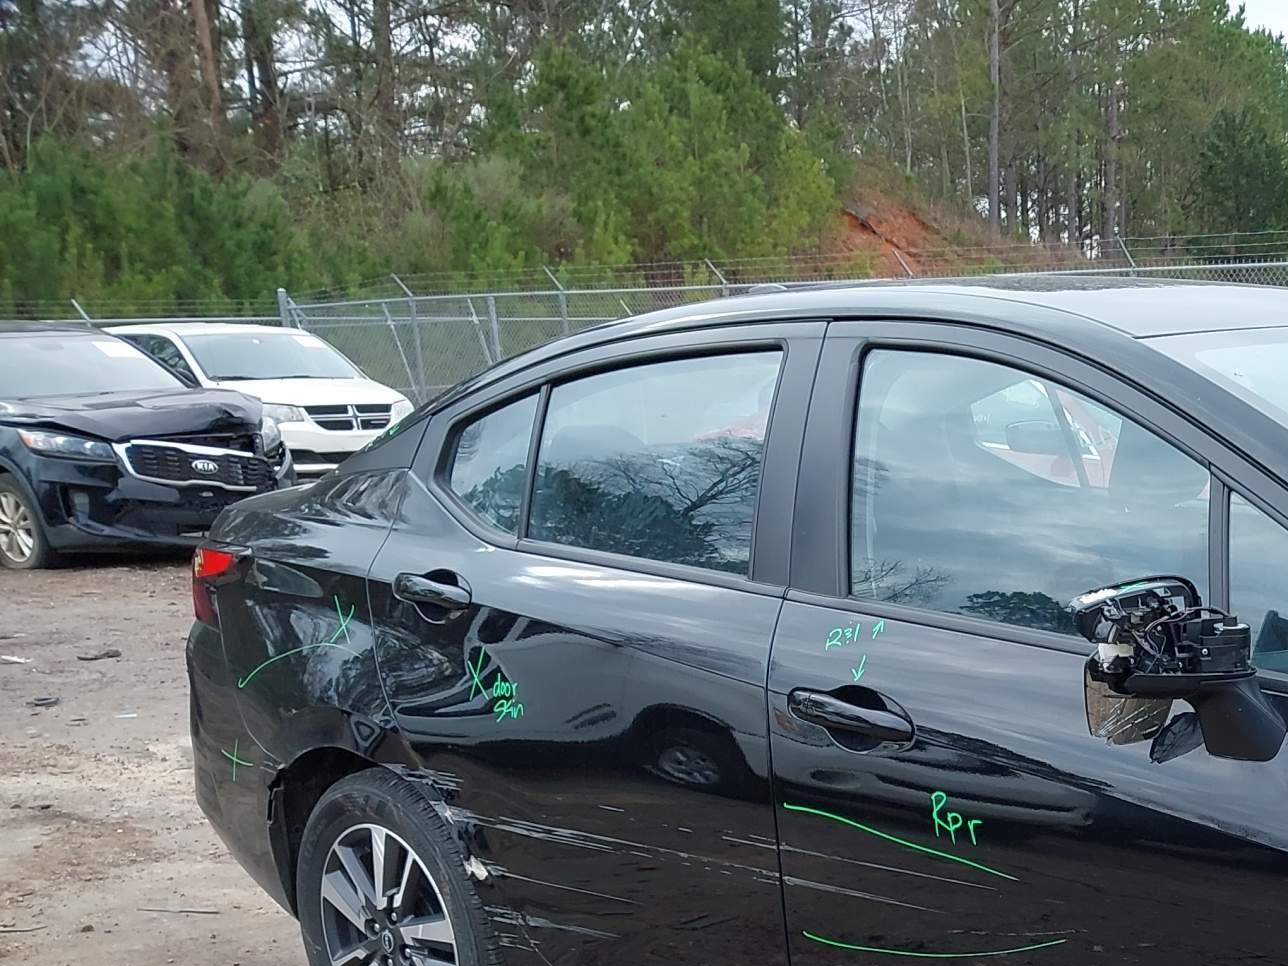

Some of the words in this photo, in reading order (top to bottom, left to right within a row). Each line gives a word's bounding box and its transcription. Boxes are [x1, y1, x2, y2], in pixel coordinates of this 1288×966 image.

[193, 461, 217, 472] KIA
[492, 672, 519, 698] door
[930, 790, 984, 847] Rpr
